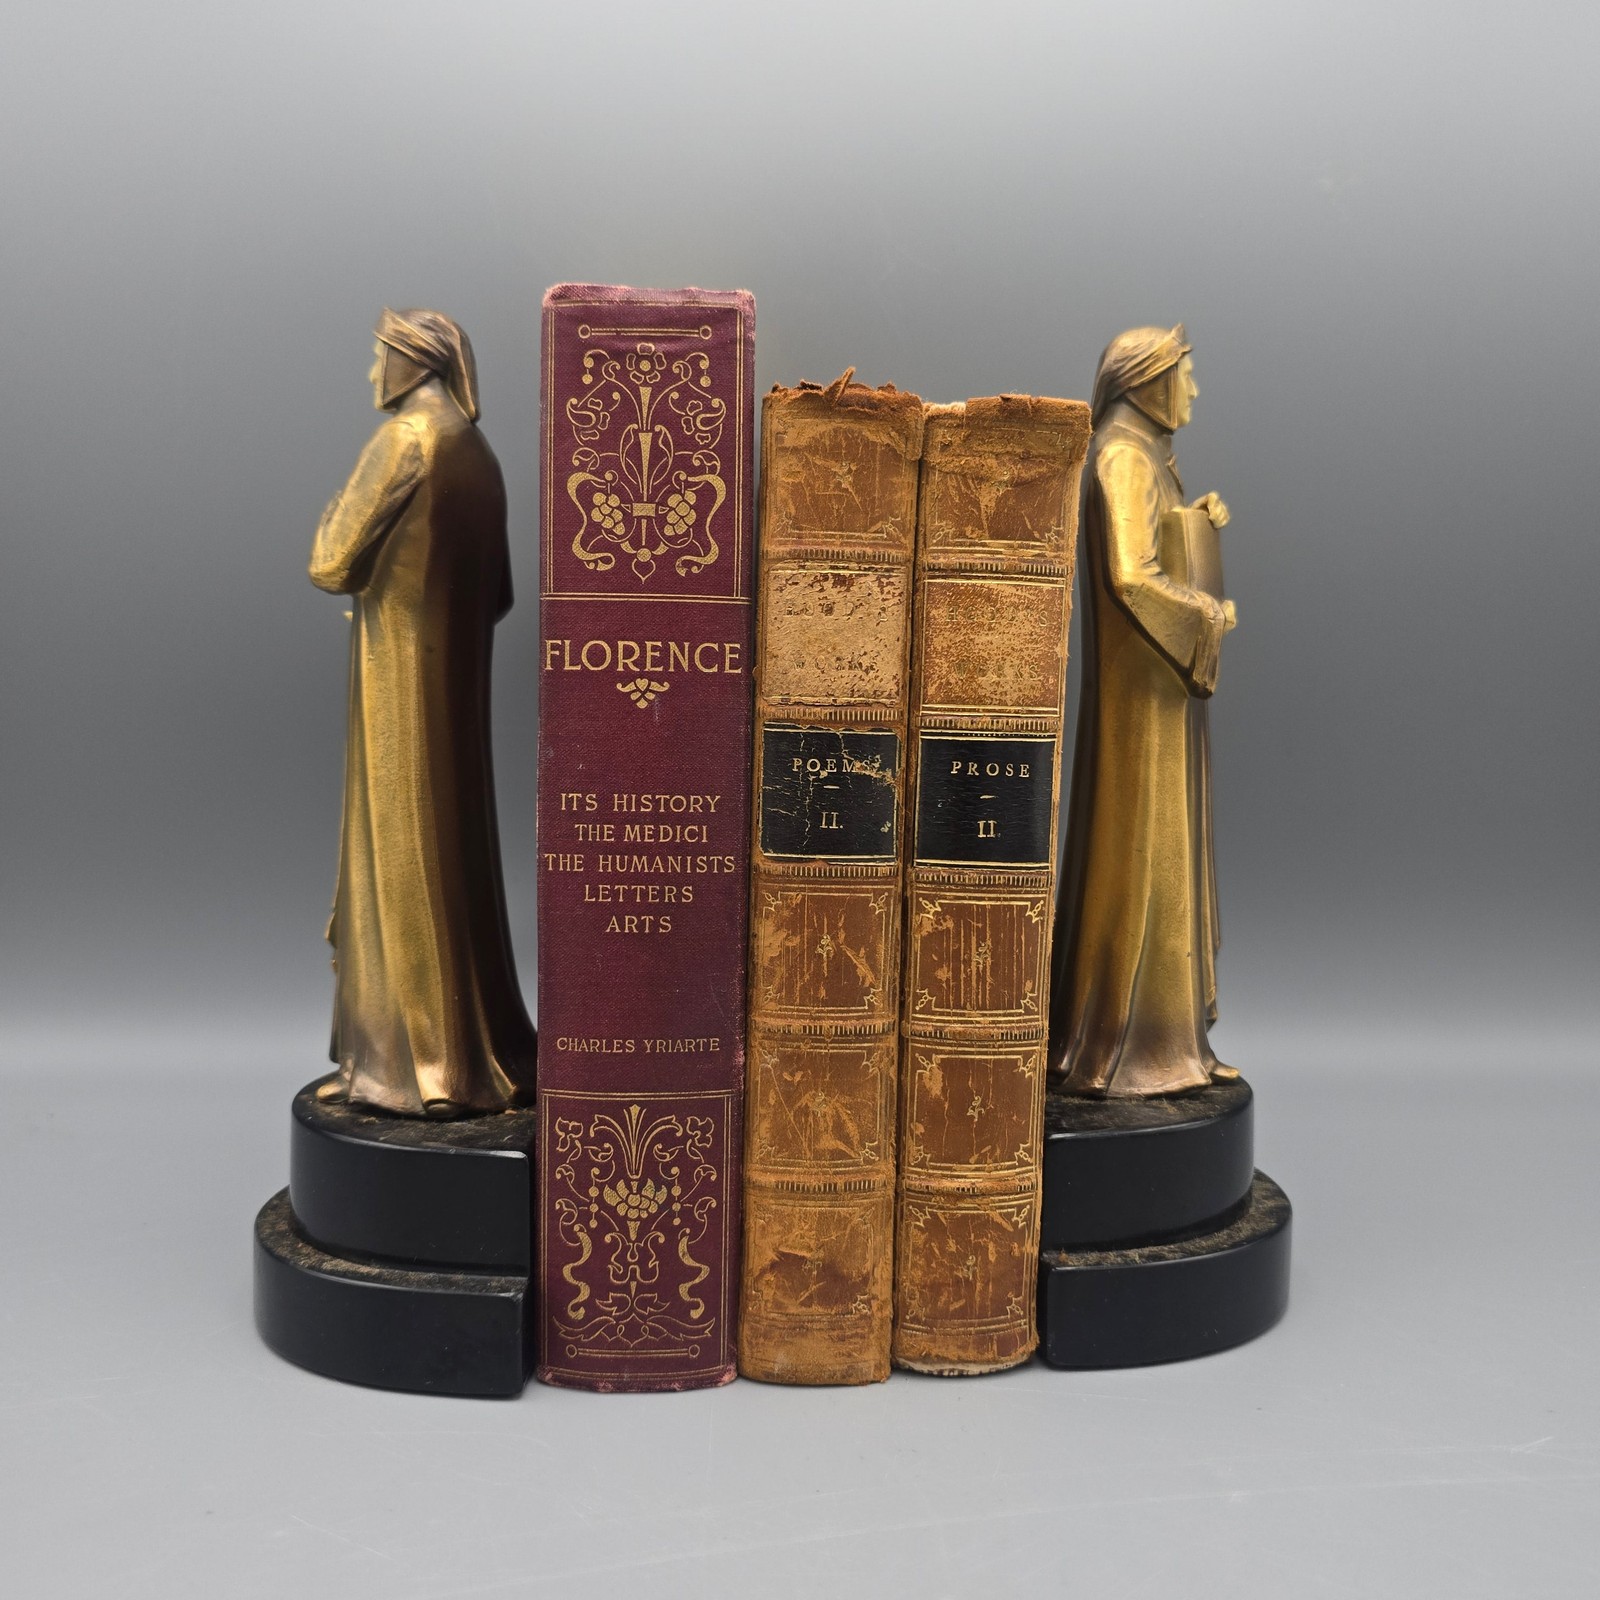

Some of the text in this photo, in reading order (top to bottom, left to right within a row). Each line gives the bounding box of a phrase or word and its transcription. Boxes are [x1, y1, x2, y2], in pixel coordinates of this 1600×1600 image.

[545, 639, 742, 674] FLORENCE
[951, 761, 1030, 778] PROSE
[561, 793, 721, 813] ITS HISTORY
[574, 824, 708, 843] THE MEDICI
[544, 853, 736, 873] THE HUMANISTS
[584, 884, 694, 903] LETTERS
[605, 915, 672, 933] ARTS
[556, 1037, 720, 1053] CHARLES YRIARTE
